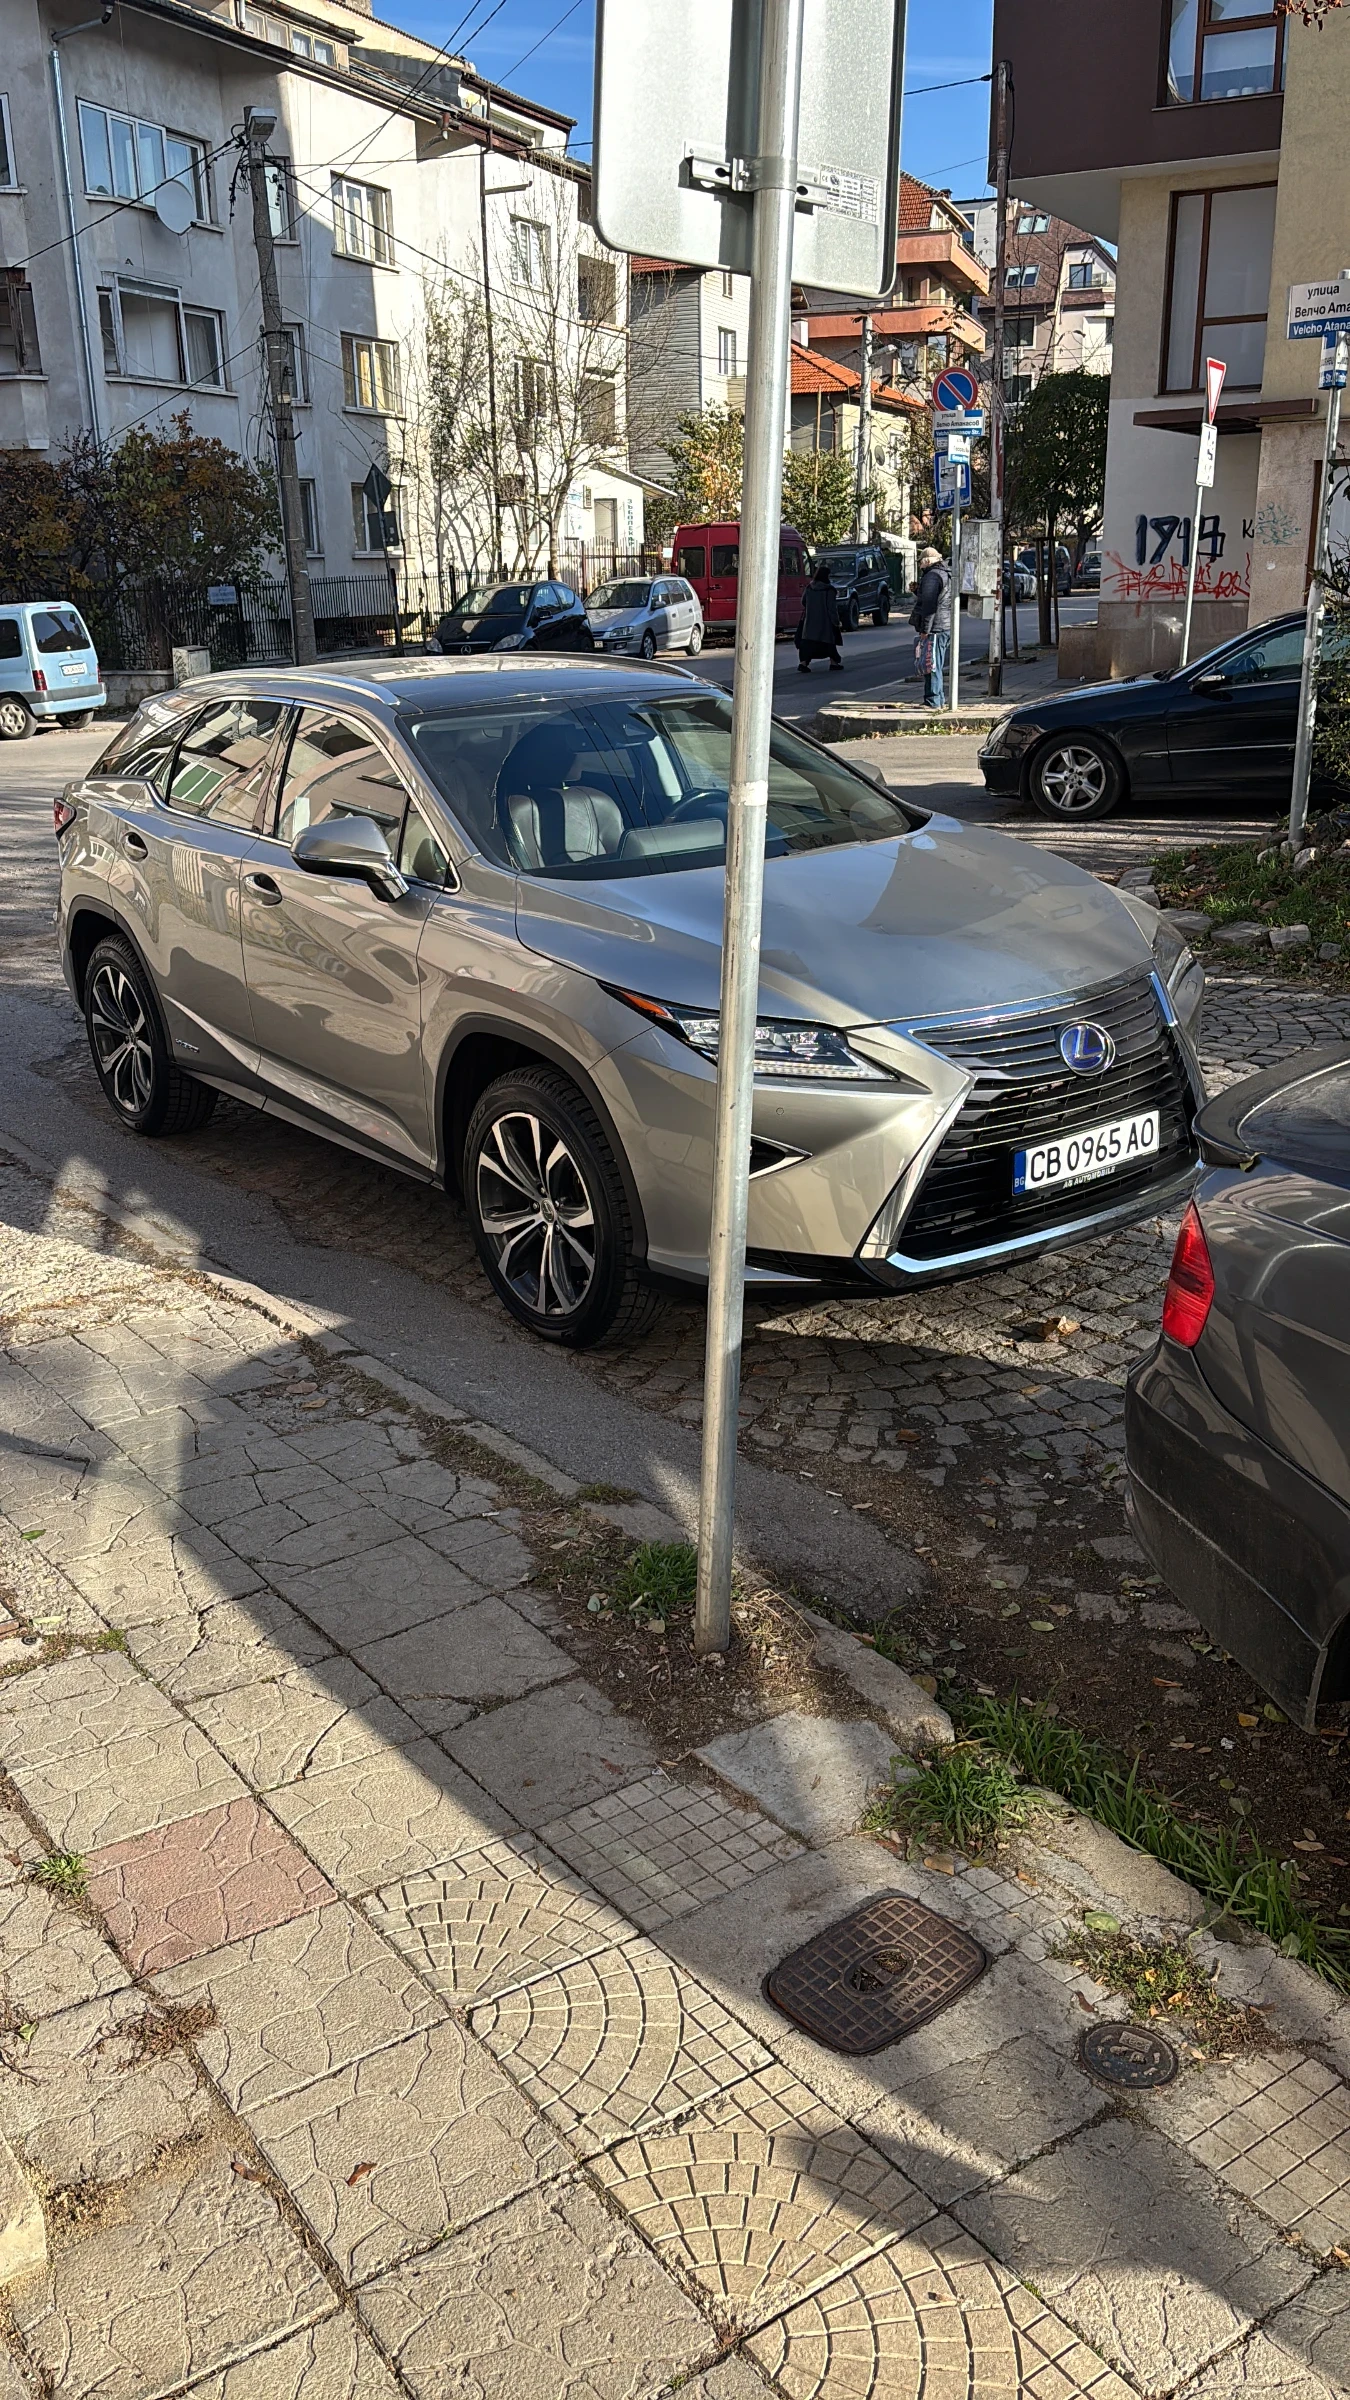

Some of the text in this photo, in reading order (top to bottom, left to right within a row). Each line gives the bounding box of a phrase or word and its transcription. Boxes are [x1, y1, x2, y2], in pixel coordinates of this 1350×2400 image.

[1308, 285, 1340, 300] улица
[1295, 305, 1326, 318] Велчо
[1293, 322, 1323, 336] Velcho
[1031, 1117, 1154, 1182] CB 0965 AO
[1014, 1176, 1025, 1188] BG
[890, 1979, 934, 2013] ХИДРАНТ
